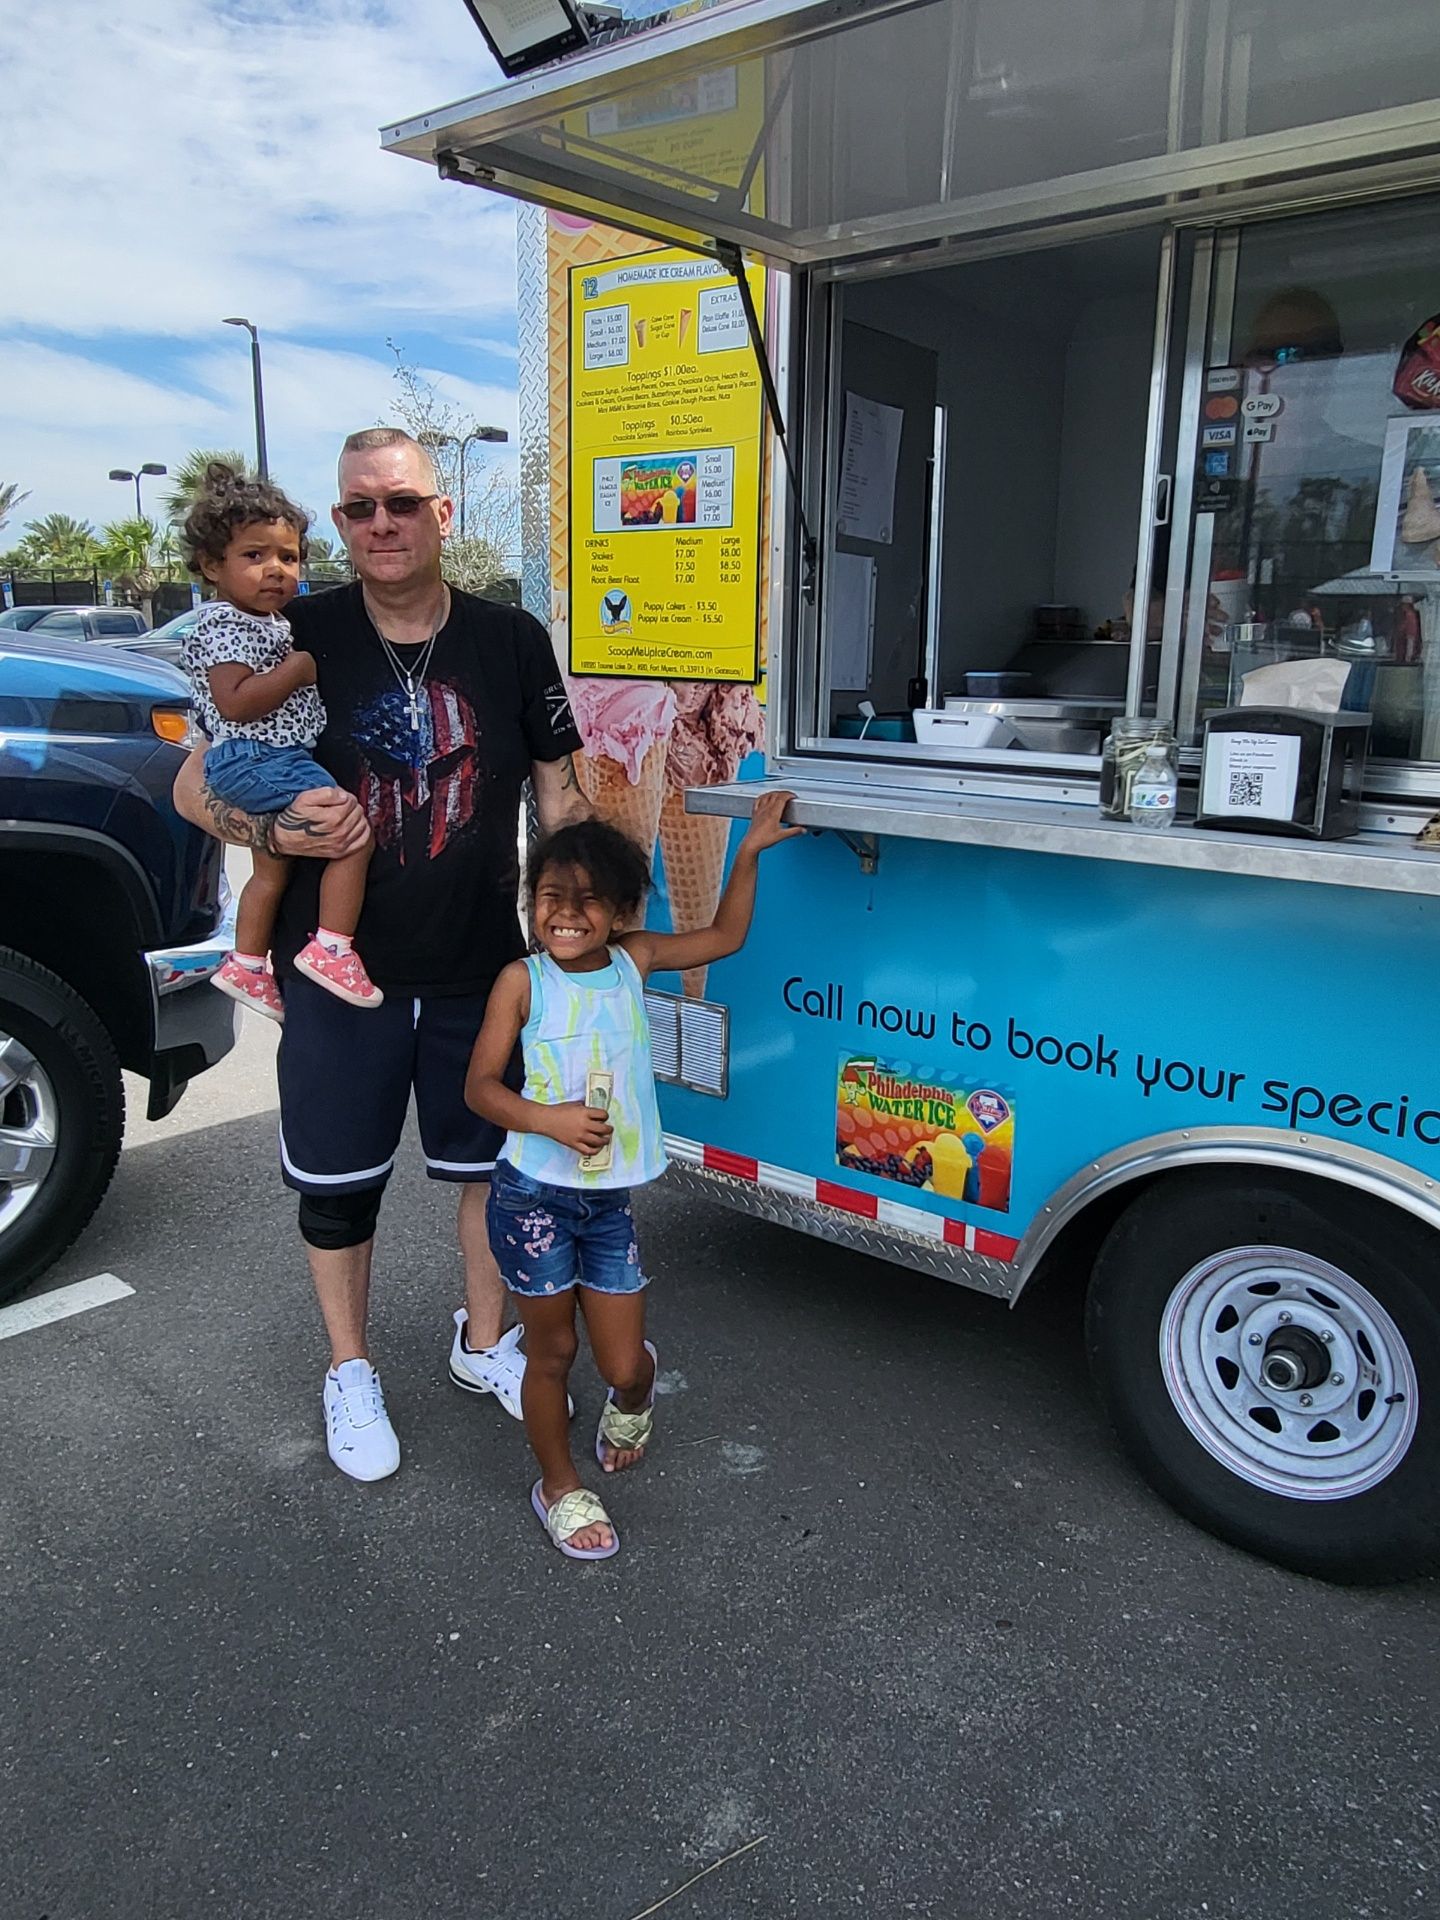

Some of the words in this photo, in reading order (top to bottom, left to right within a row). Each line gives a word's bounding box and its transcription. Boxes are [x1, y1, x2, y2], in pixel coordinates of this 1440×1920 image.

[617, 269, 657, 283] HOMEMADE
[659, 268, 670, 278] ICE
[670, 266, 696, 278] CREAM
[581, 277, 598, 300] 12
[710, 292, 738, 304] EXTRAS
[590, 328, 604, 338] Small
[586, 341, 607, 349] Medium
[611, 336, 626, 345] $7.00
[589, 349, 604, 361] Large
[627, 370, 662, 382] Toppings
[664, 364, 698, 376] $1.00ea.
[1246, 401, 1255, 411] G
[1257, 401, 1274, 412] Pay
[622, 420, 656, 432] Toppings
[671, 414, 703, 425] $0.50ea
[1208, 430, 1232, 440] VISA
[1253, 427, 1268, 438] Pay
[705, 454, 722, 463] Small
[704, 465, 722, 474] $5.00
[702, 480, 725, 488] Medium
[705, 490, 722, 498] $6.00
[704, 504, 720, 513] Large
[585, 539, 609, 548] DRINKS
[675, 537, 704, 546] Medium
[720, 536, 741, 546] Large
[591, 552, 614, 560] Shakes
[675, 549, 696, 558] $7.00
[720, 547, 741, 557] $8.00
[591, 564, 609, 572] Malts
[675, 561, 695, 571] $7.50
[720, 560, 741, 570] $8.50
[591, 575, 606, 584] Root
[608, 576, 622, 584] Beer
[624, 575, 640, 584] Float
[675, 574, 695, 583] $7.00
[720, 573, 740, 583] $8.00
[644, 601, 664, 612] Puppy
[666, 602, 686, 610] Cakes
[697, 601, 717, 611] $3.50
[638, 614, 658, 624] Puppy
[660, 614, 669, 622] Ice
[671, 614, 692, 622] Cream
[703, 614, 723, 623] $5.50
[608, 646, 712, 660] ScoopMeUpIceCream.com
[782, 976, 843, 1022] Call
[857, 1000, 936, 1039] now
[951, 1011, 992, 1051] to
[1007, 1017, 1119, 1078] book
[1136, 1053, 1246, 1102] your
[868, 1071, 954, 1106] Philadelphia
[867, 1091, 924, 1122] WATER
[927, 1099, 957, 1130] ICE
